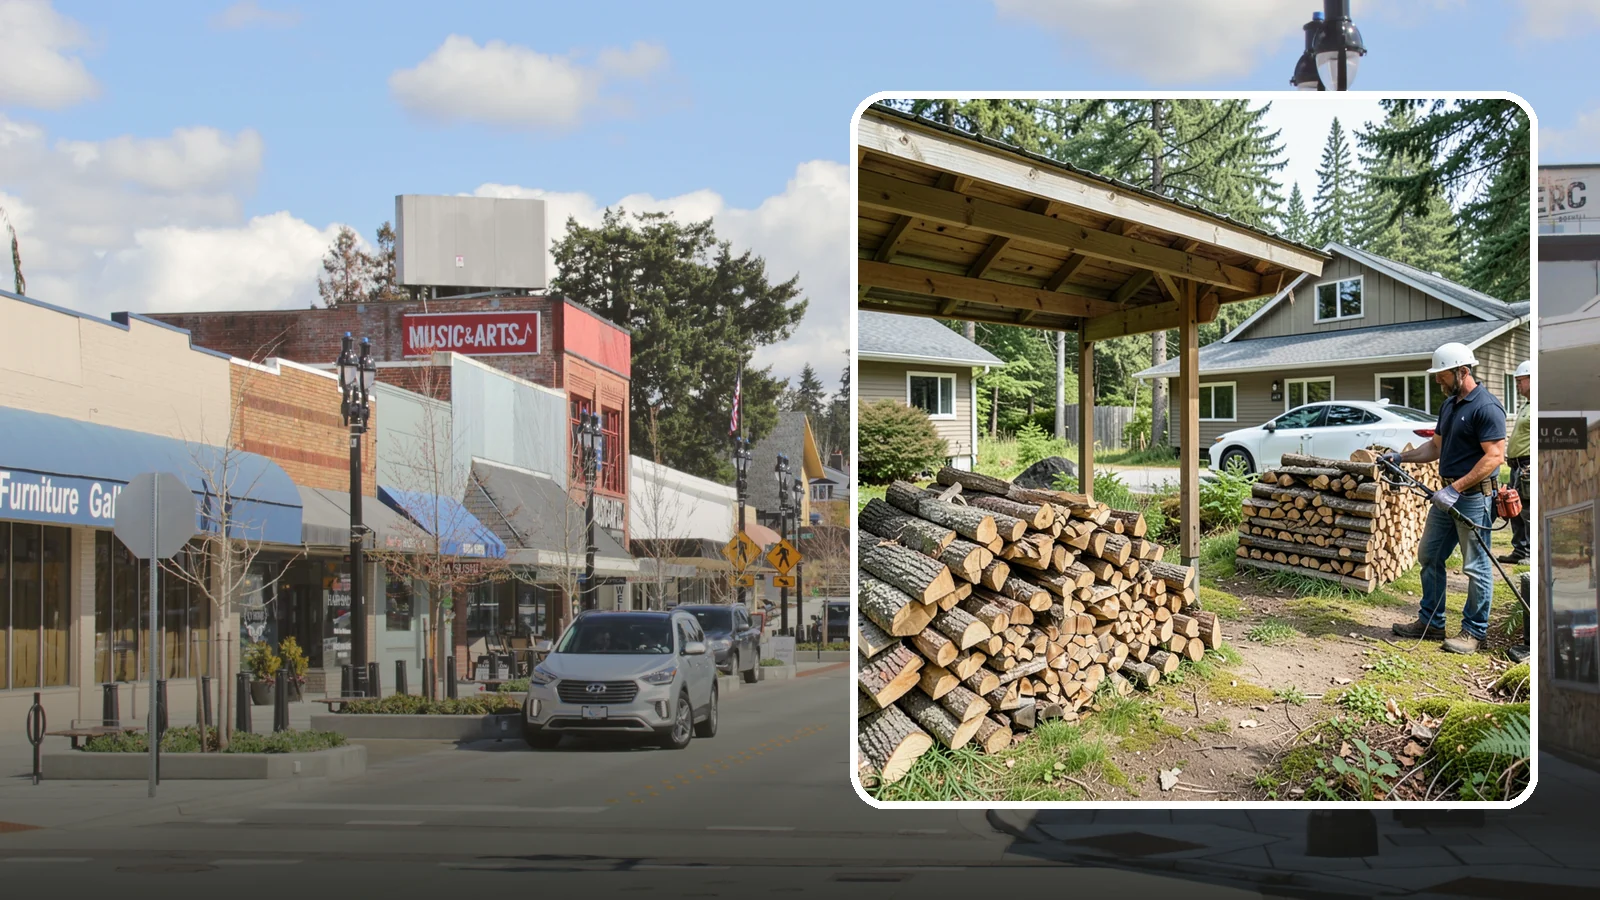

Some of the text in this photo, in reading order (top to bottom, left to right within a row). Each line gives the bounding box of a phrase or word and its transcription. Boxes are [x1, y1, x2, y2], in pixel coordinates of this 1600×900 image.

[409, 322, 520, 348] MUSIC&ARTS
[0, 471, 122, 519] Furniture Gal
